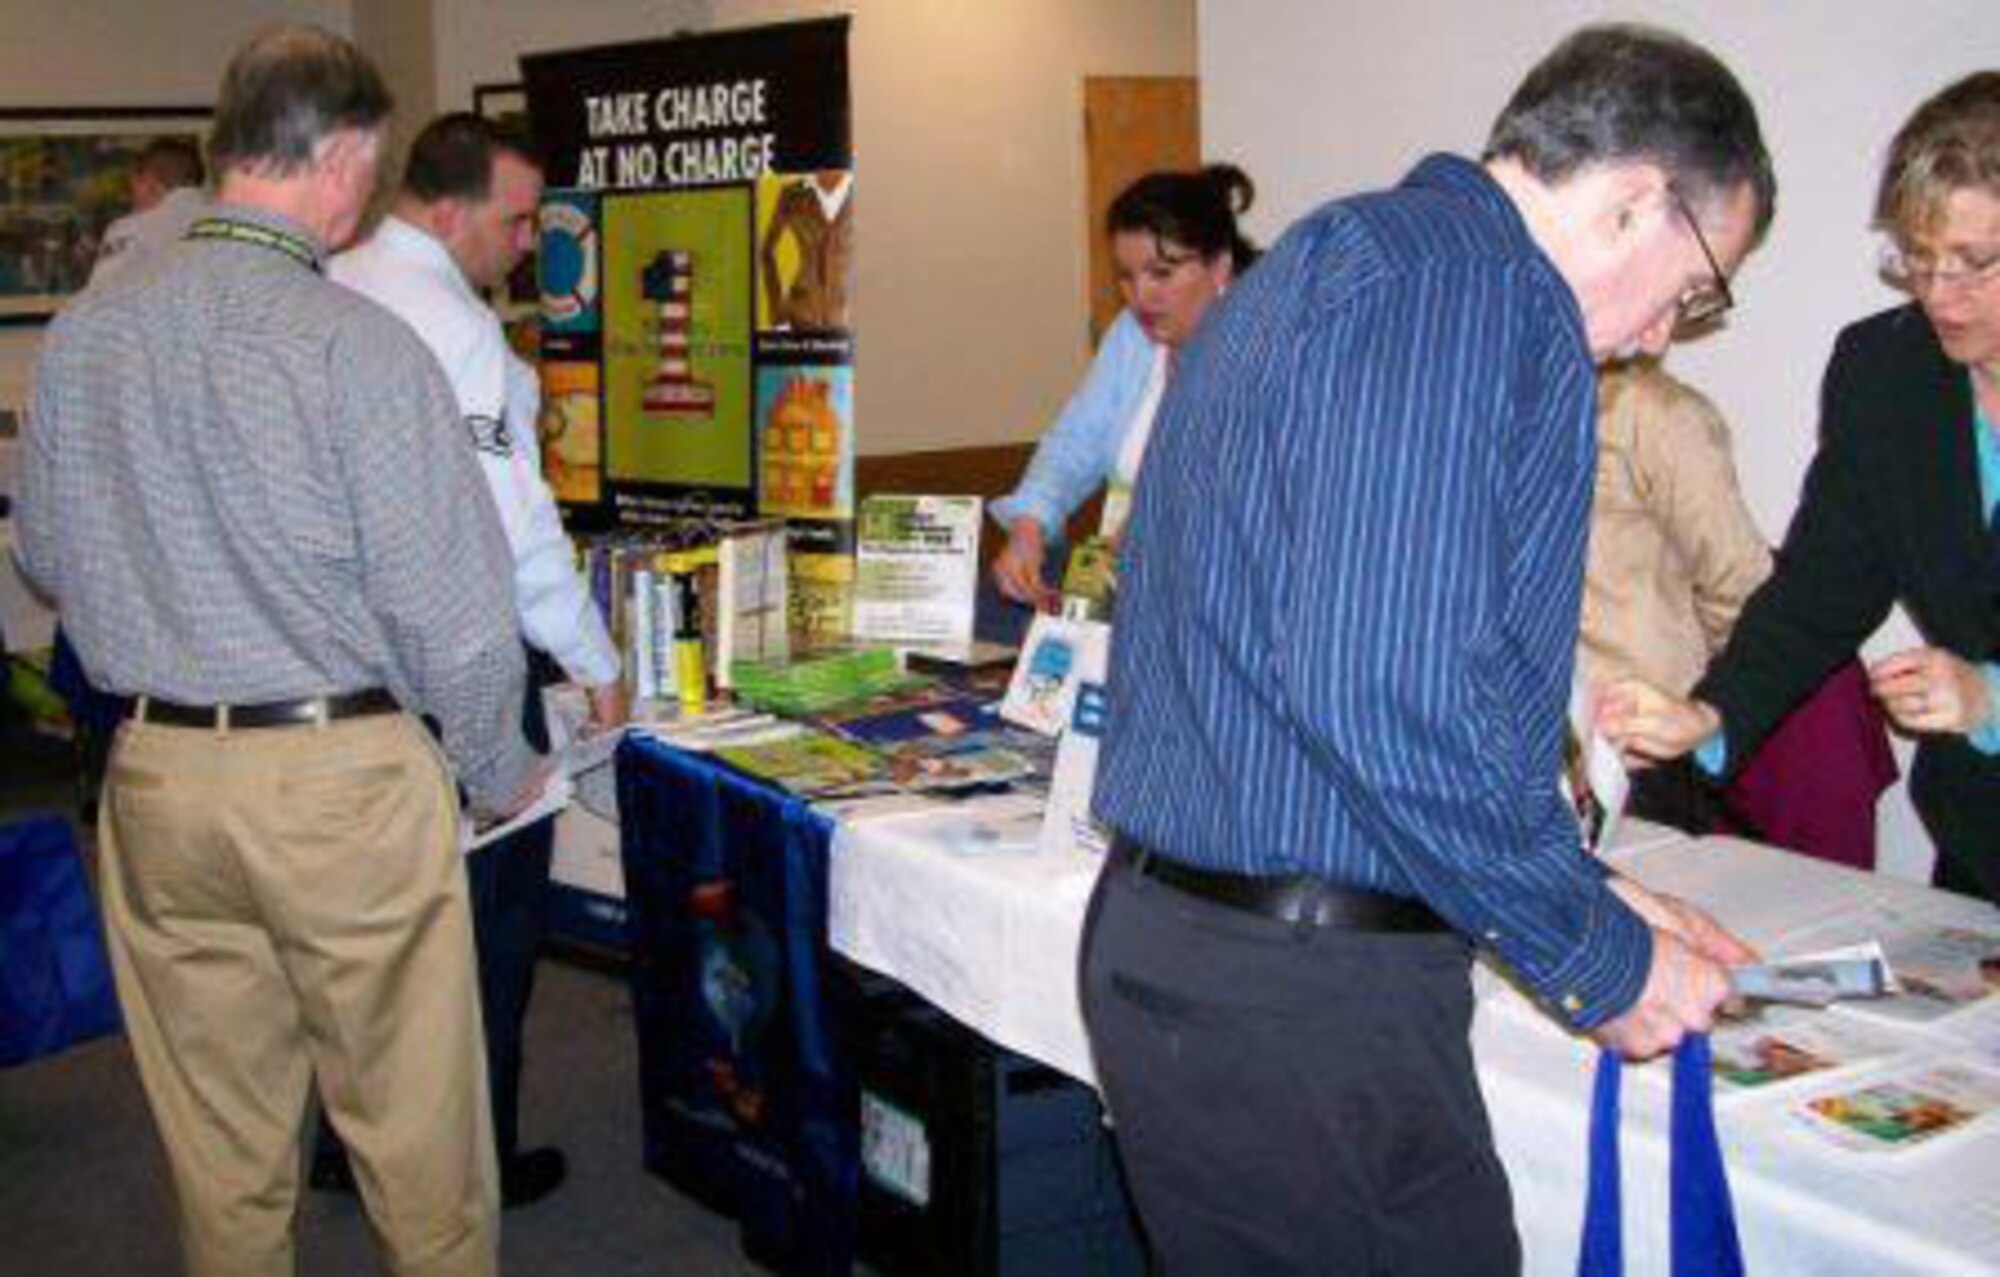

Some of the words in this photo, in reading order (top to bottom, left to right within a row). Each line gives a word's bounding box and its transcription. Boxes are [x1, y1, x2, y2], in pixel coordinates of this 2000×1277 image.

[585, 92, 648, 137] TAKE
[655, 79, 766, 131] CHARGE
[577, 146, 608, 189] AT
[617, 142, 657, 187] NO
[664, 133, 776, 182] CHARGE
